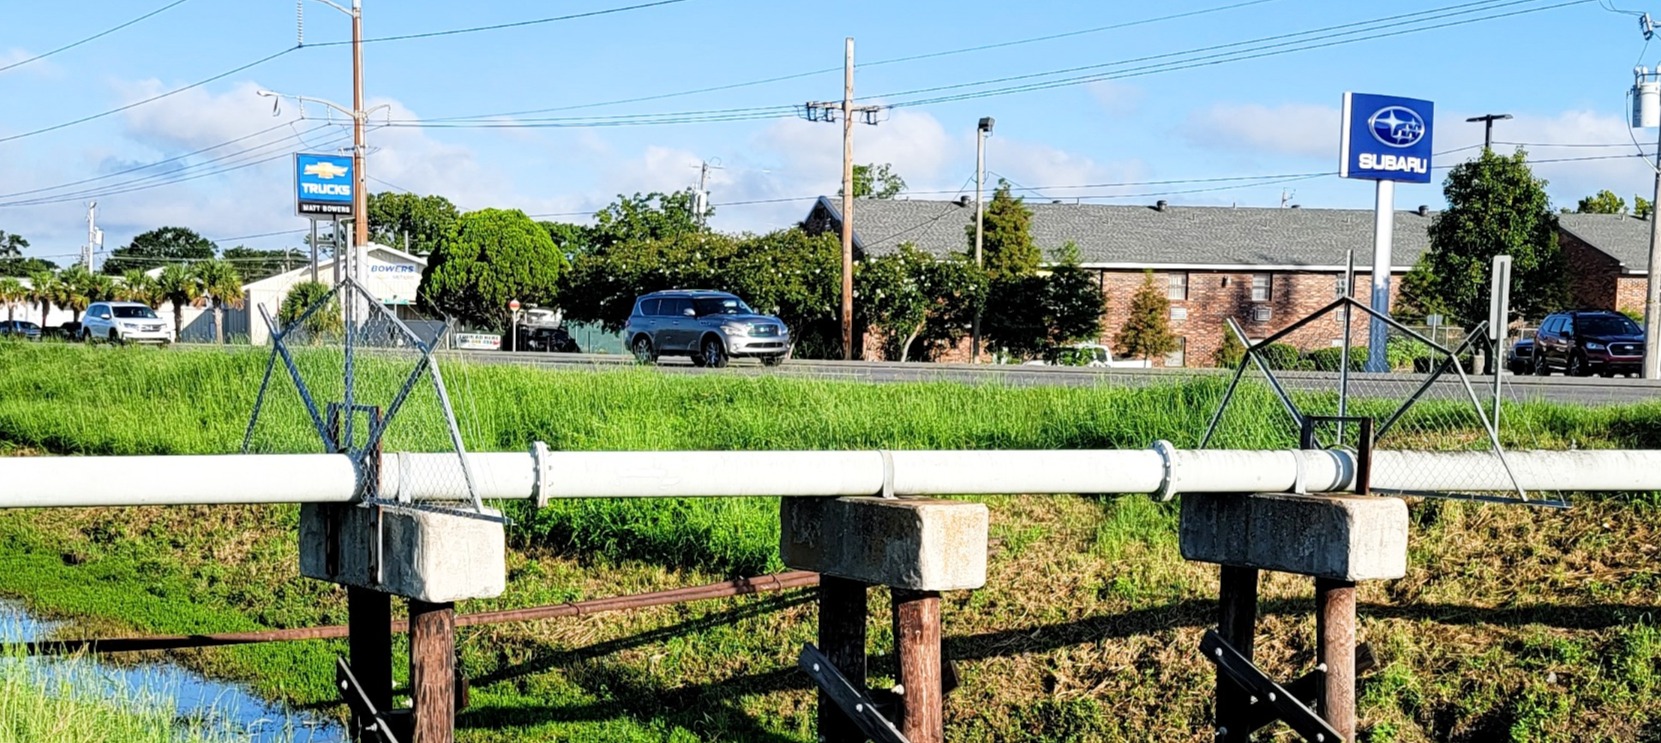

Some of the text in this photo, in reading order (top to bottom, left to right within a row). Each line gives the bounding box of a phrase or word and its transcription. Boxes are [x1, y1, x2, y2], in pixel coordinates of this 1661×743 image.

[1359, 153, 1427, 174] SUBARU
[301, 182, 350, 196] TRUCKS
[302, 204, 350, 213] MATT BOWERS
[371, 264, 415, 273] BOWERS
